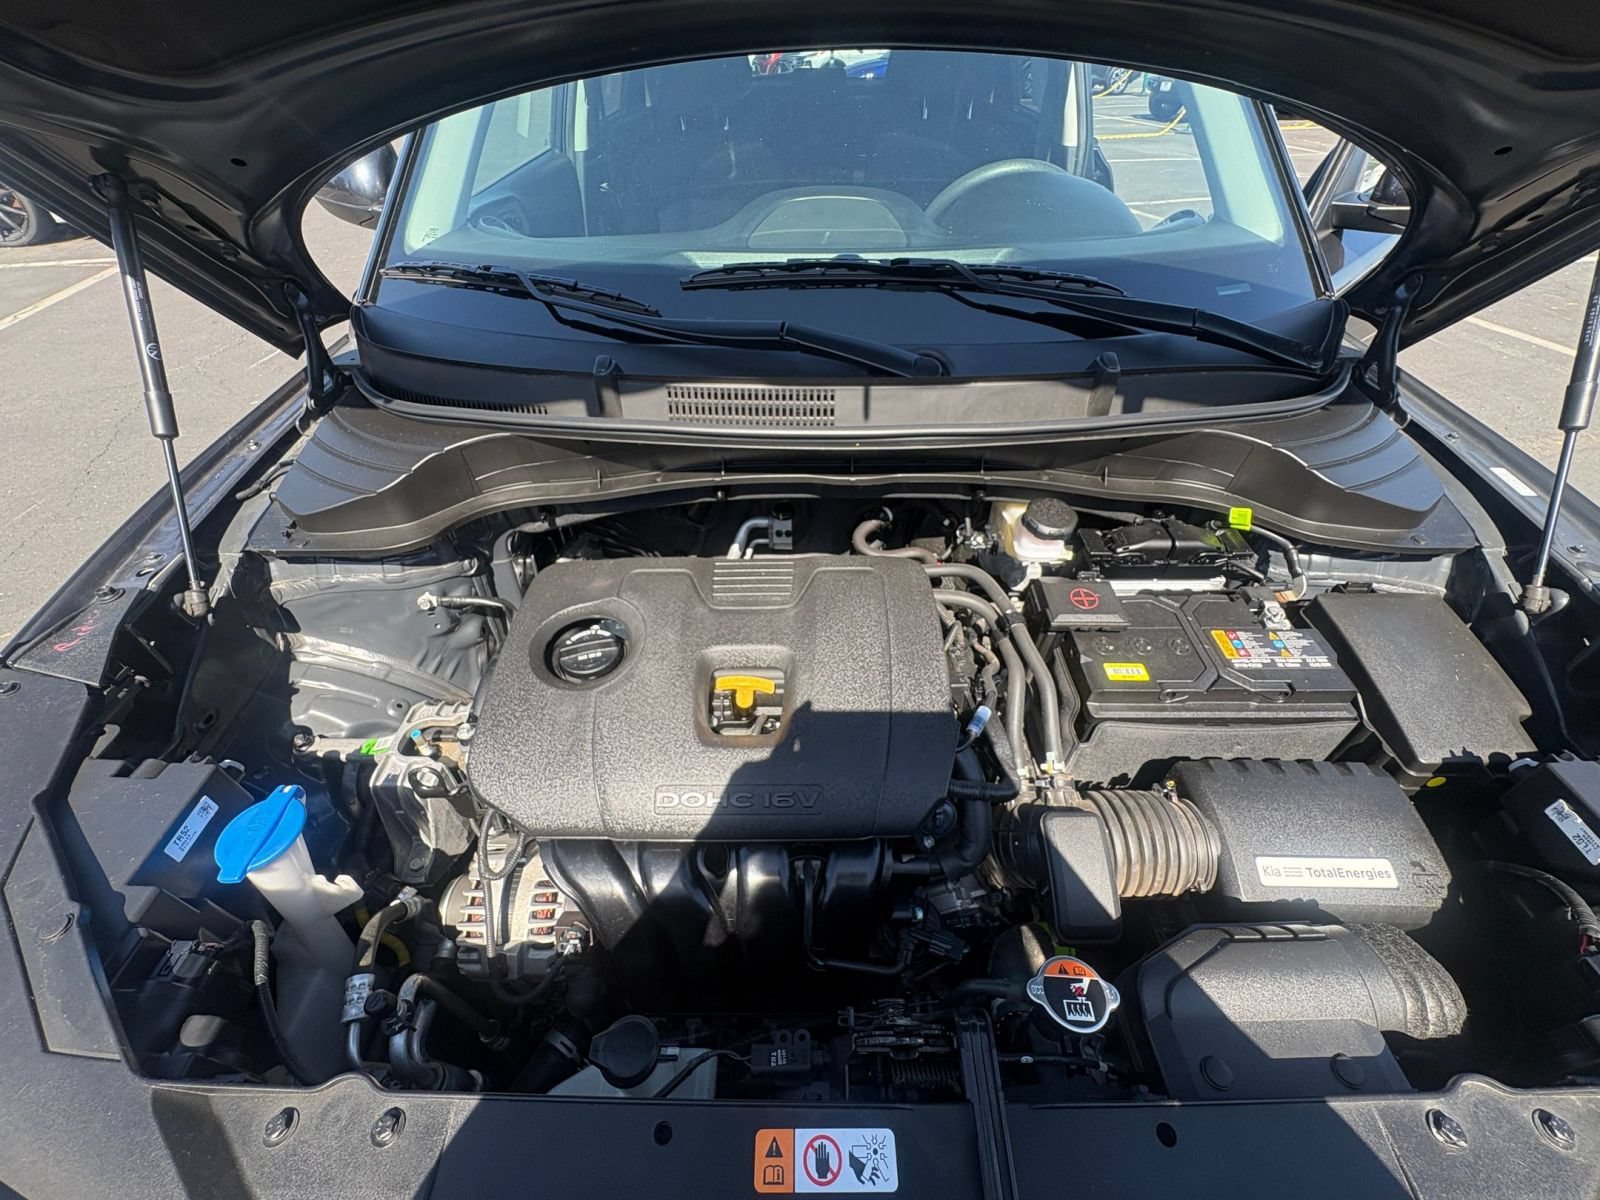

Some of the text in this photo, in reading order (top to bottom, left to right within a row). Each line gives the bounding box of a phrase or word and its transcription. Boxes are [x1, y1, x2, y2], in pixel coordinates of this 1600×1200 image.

[656, 791, 822, 808] DOHC 16V
[1262, 866, 1392, 881] Kia TotalEnergies
